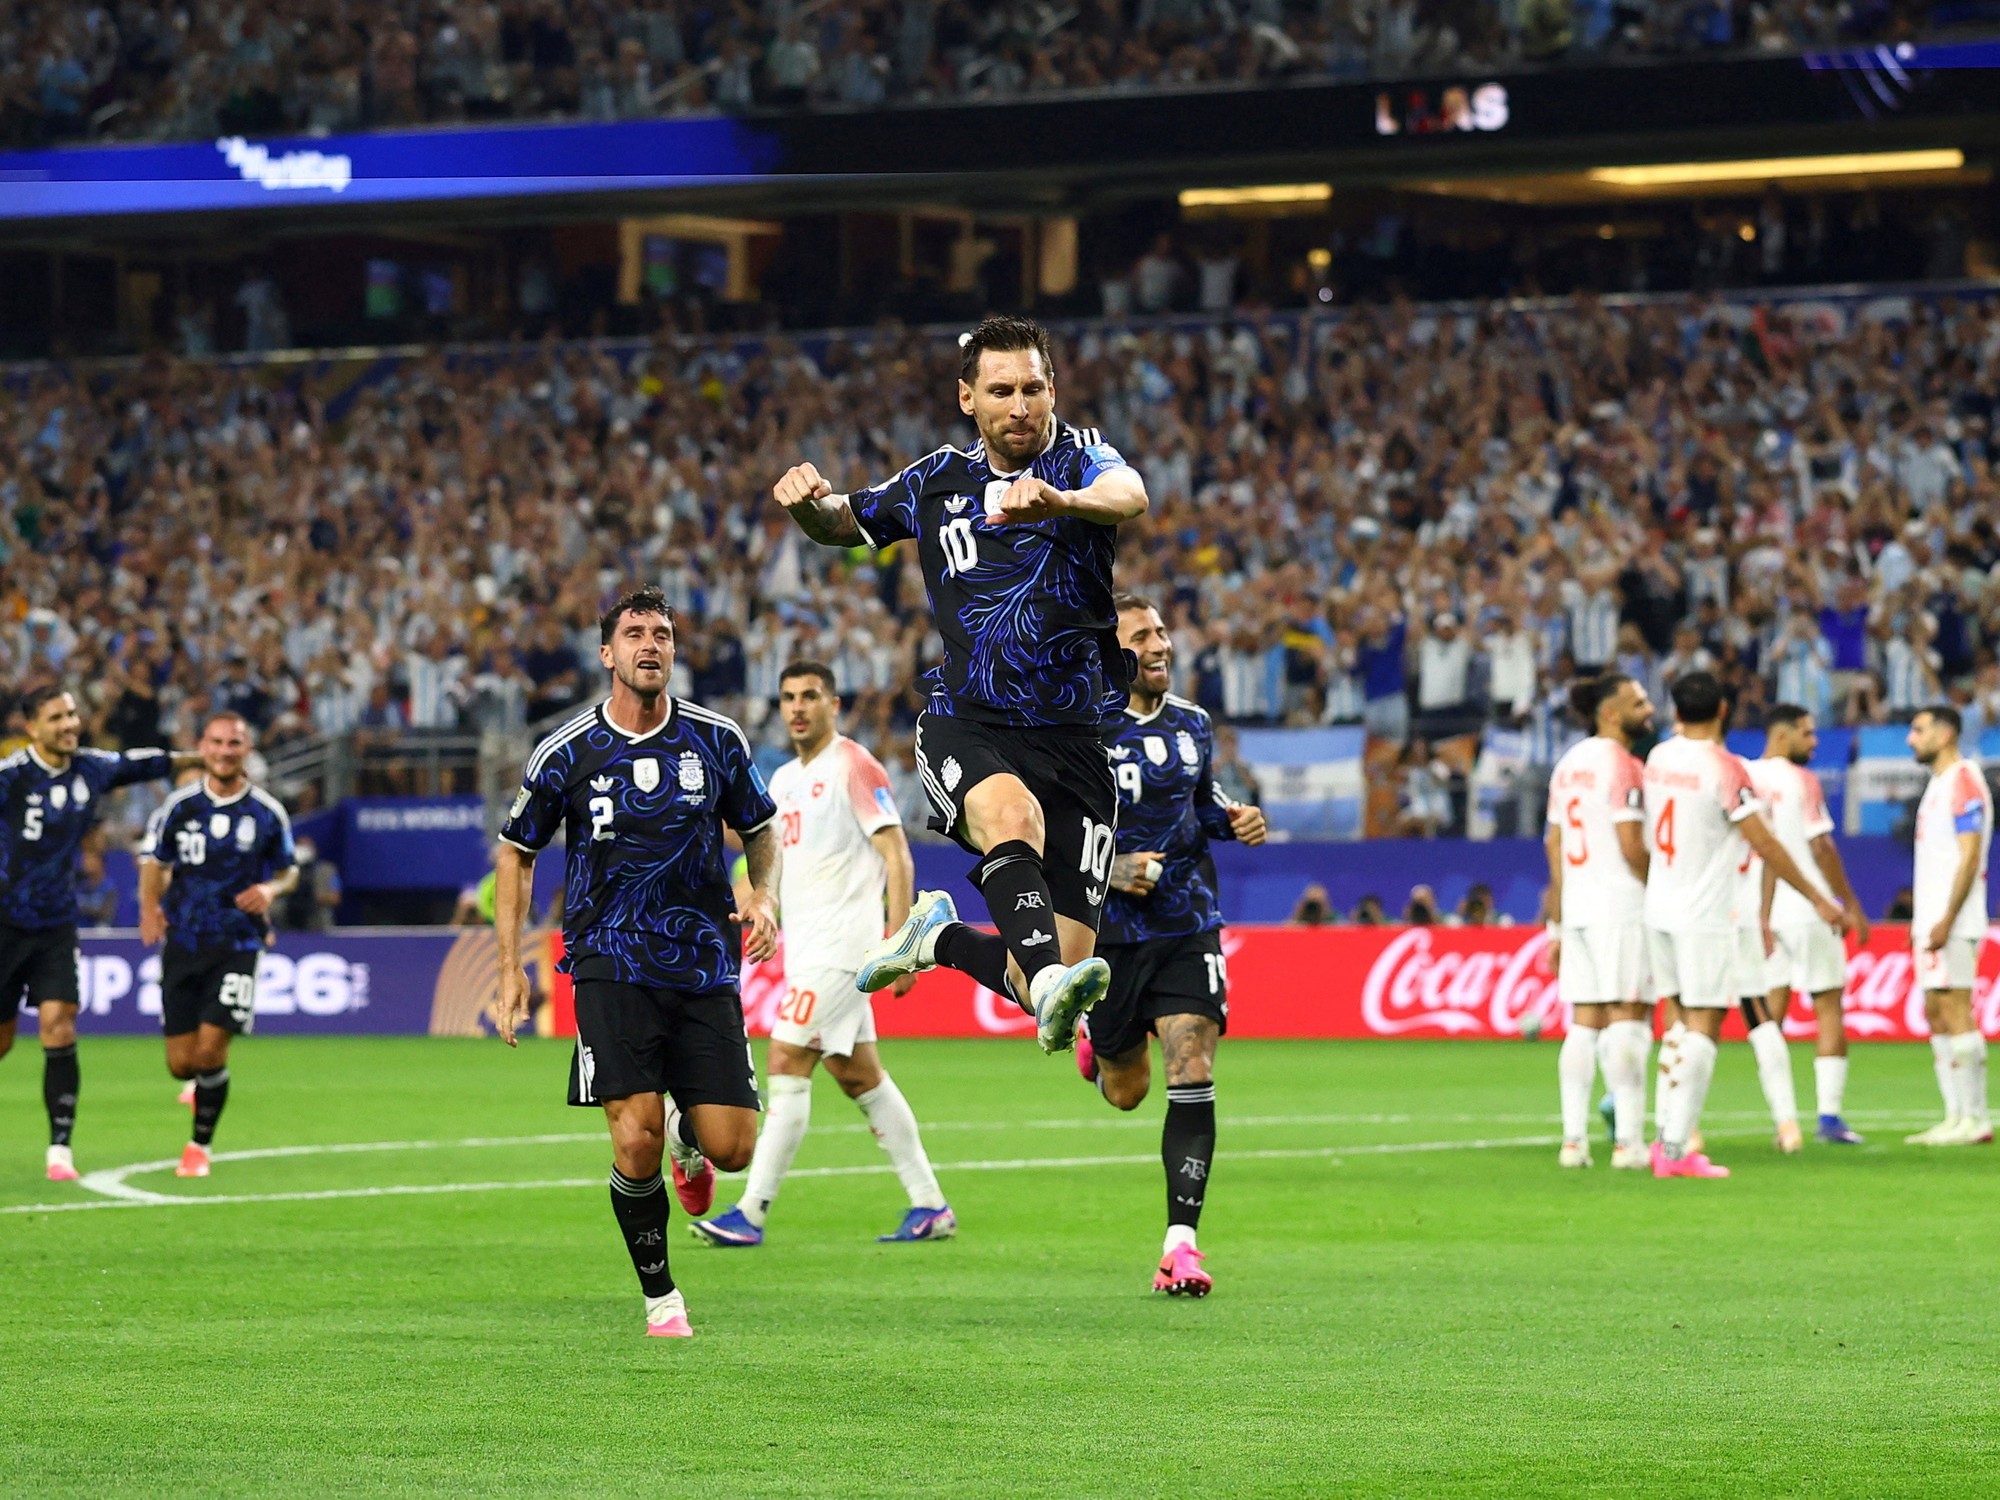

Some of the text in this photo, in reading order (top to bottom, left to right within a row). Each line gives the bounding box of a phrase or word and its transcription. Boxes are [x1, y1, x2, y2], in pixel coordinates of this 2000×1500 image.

[939, 518, 979, 579] 10
[1116, 762, 1142, 804] 9
[22, 806, 45, 841] 5
[588, 796, 618, 842] 2
[782, 811, 802, 848] 20
[1566, 797, 1589, 867] 5
[1654, 797, 1677, 868] 4
[175, 831, 207, 866] 20
[1079, 815, 1114, 883] 10
[218, 972, 253, 1007] 20
[780, 988, 818, 1026] 20
